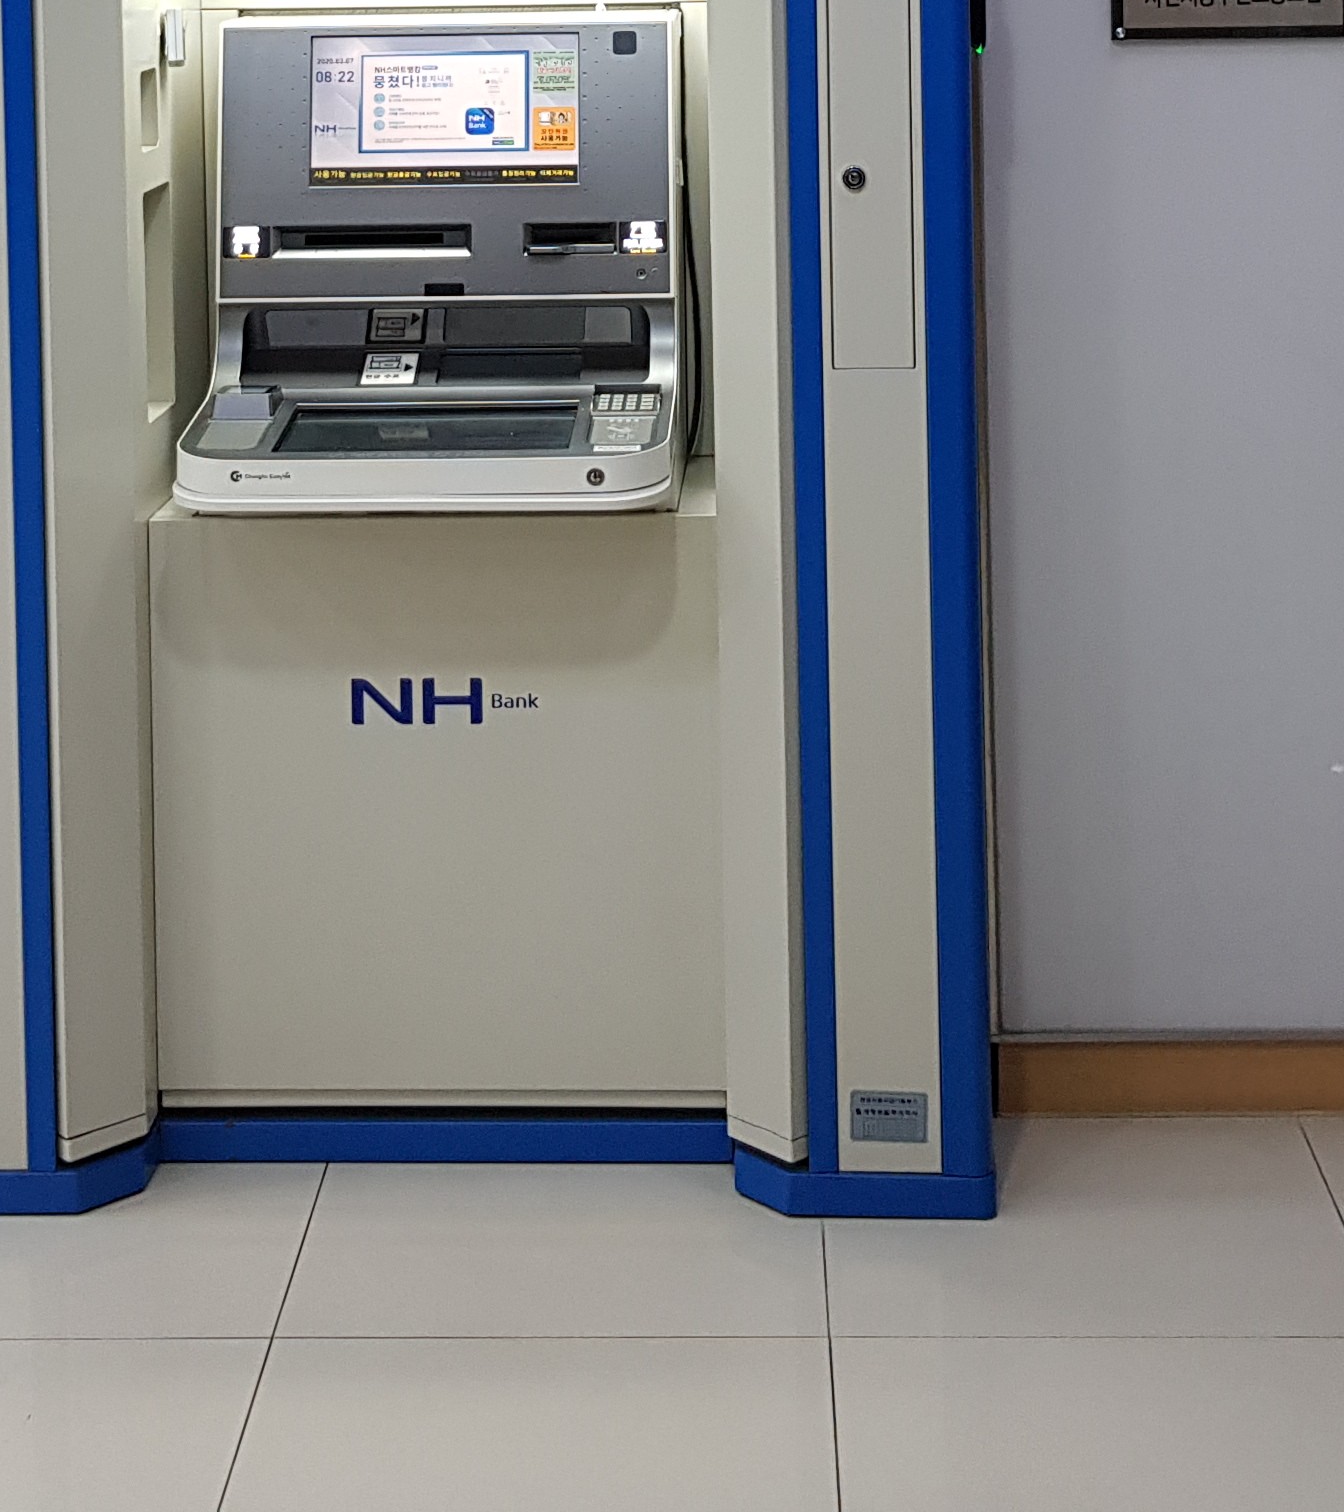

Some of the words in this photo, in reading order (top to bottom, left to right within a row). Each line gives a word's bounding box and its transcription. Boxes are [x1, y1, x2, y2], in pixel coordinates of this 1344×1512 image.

[316, 70, 355, 83] 08:22
[314, 124, 337, 134] NH
[351, 677, 483, 725] NH
[491, 693, 539, 709] Bank
